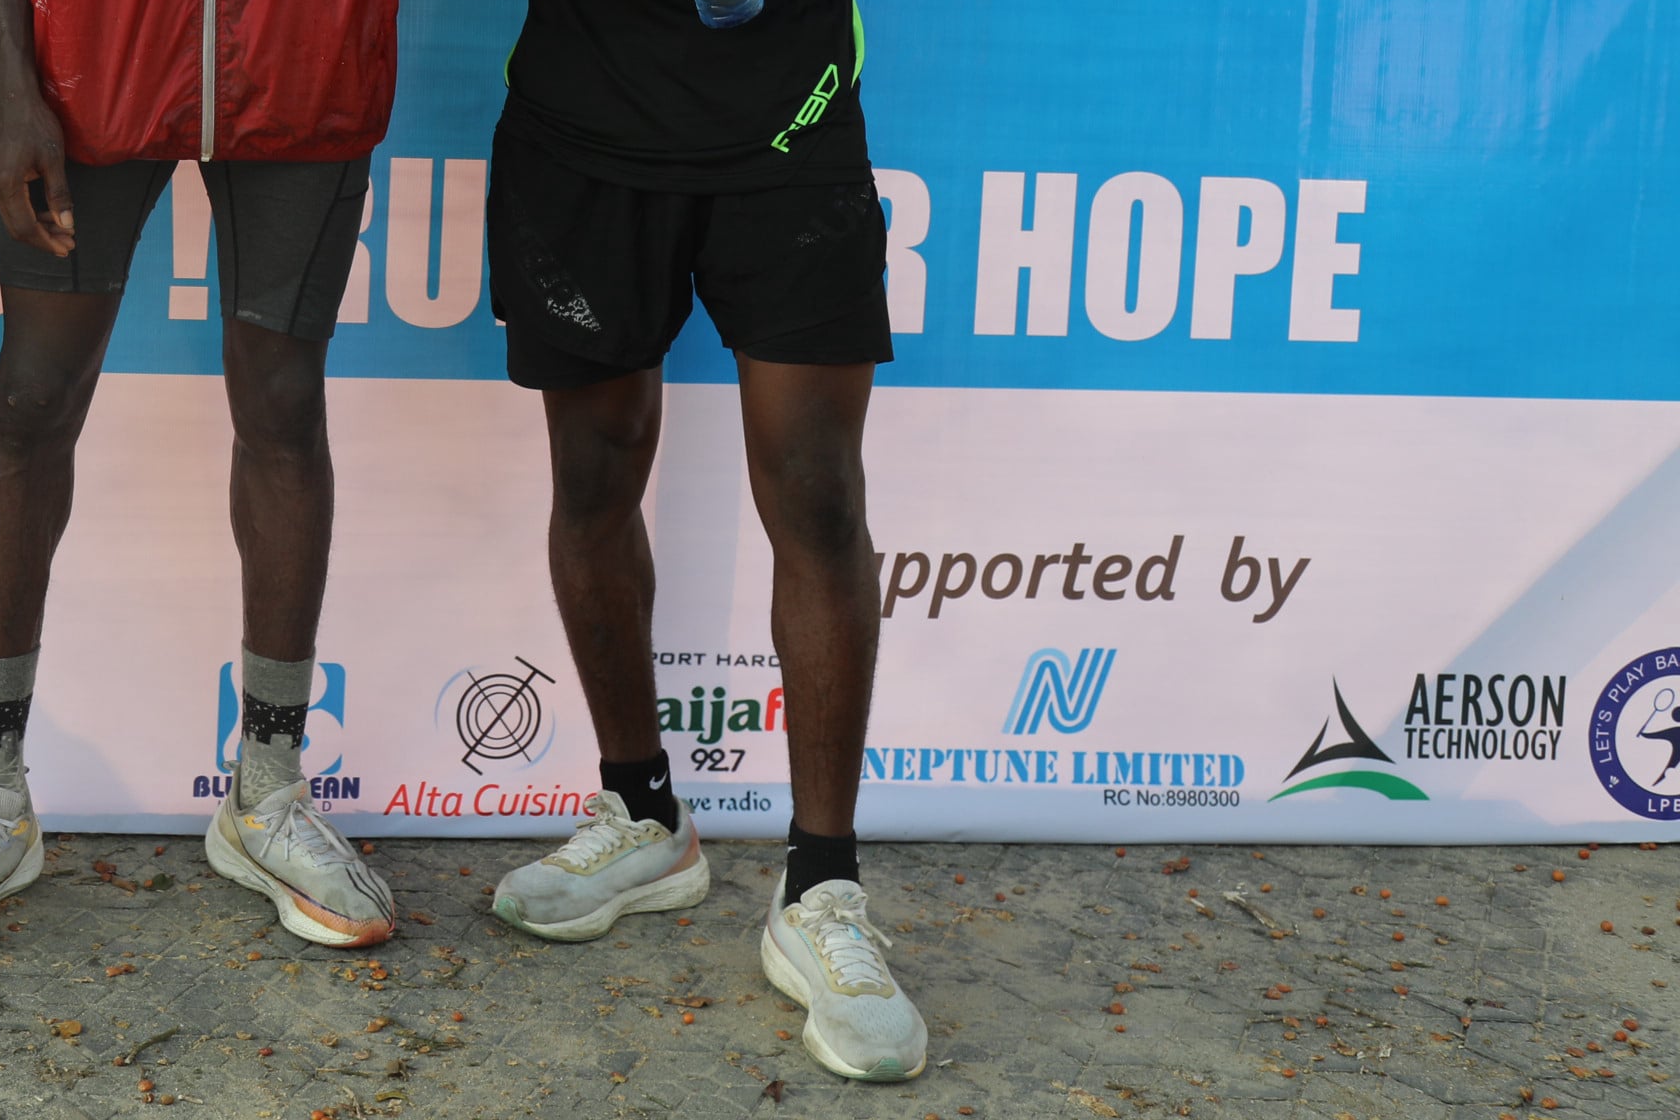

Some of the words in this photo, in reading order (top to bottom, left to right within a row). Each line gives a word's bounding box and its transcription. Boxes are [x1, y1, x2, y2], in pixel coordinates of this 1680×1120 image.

[972, 171, 1368, 343] HOPE
[873, 535, 1185, 619] pported
[1220, 535, 1312, 624] by
[1404, 673, 1567, 727] AERSON
[1595, 709, 1613, 764] LET'S
[1608, 663, 1646, 703] PLAY
[1404, 728, 1562, 761] TECHNOLOGY
[861, 748, 1058, 784] NEPTUNE
[1072, 751, 1245, 788] LIMITED
[383, 781, 463, 817] Alta
[718, 791, 772, 811] radio
[1103, 789, 1131, 806] RC
